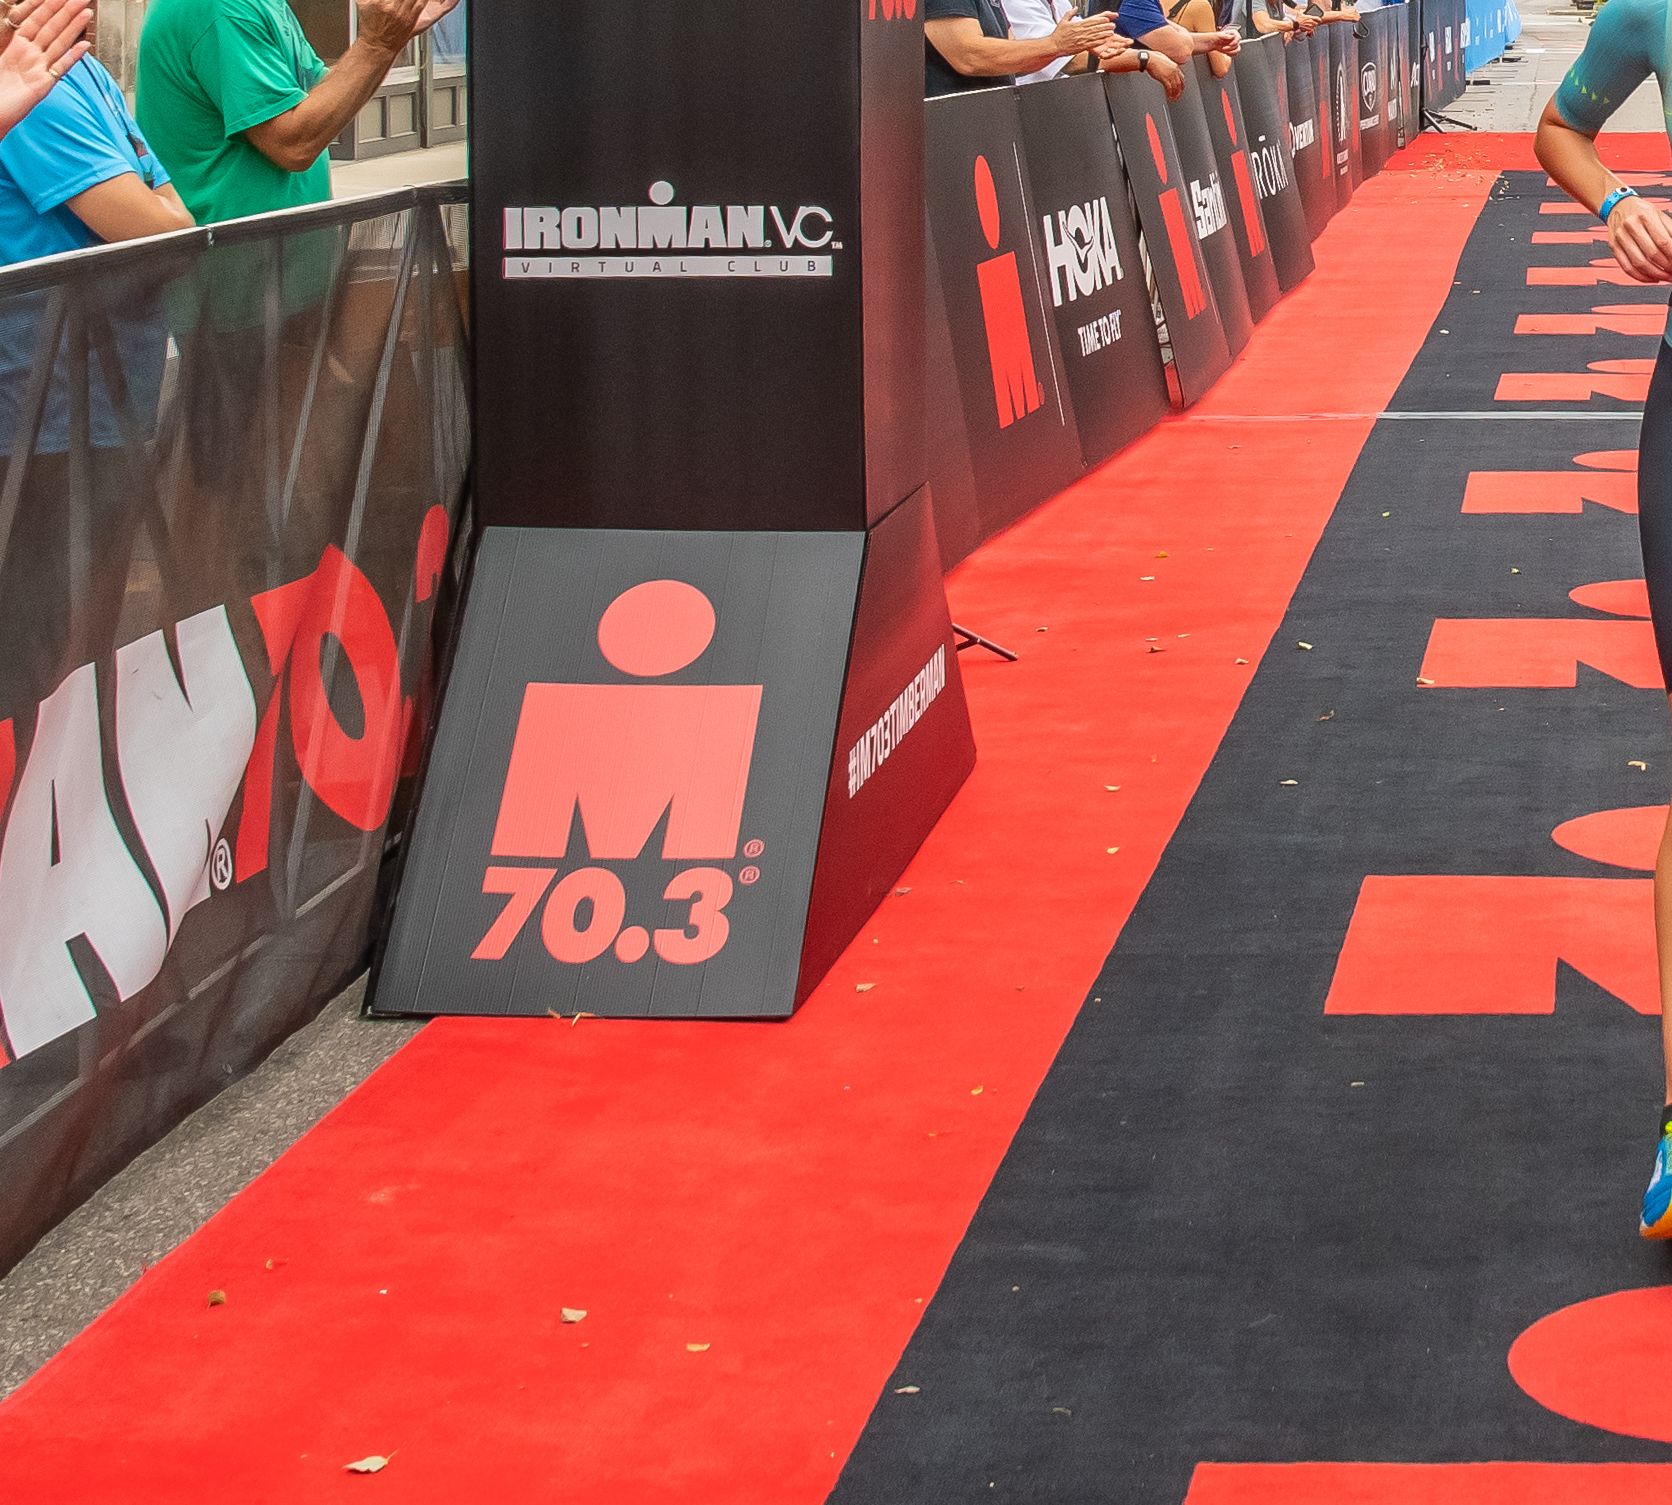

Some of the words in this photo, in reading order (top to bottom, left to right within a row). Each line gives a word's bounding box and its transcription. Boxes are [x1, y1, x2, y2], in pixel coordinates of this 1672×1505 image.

[503, 180, 765, 249] IRONMAN
[1043, 196, 1123, 307] HOKA
[521, 259, 688, 273] VIRTUAL
[727, 259, 818, 273] CLUB
[1077, 321, 1101, 357] TIME
[848, 643, 947, 799] #IM703TIMBERMAN
[470, 866, 734, 964] 70.3
